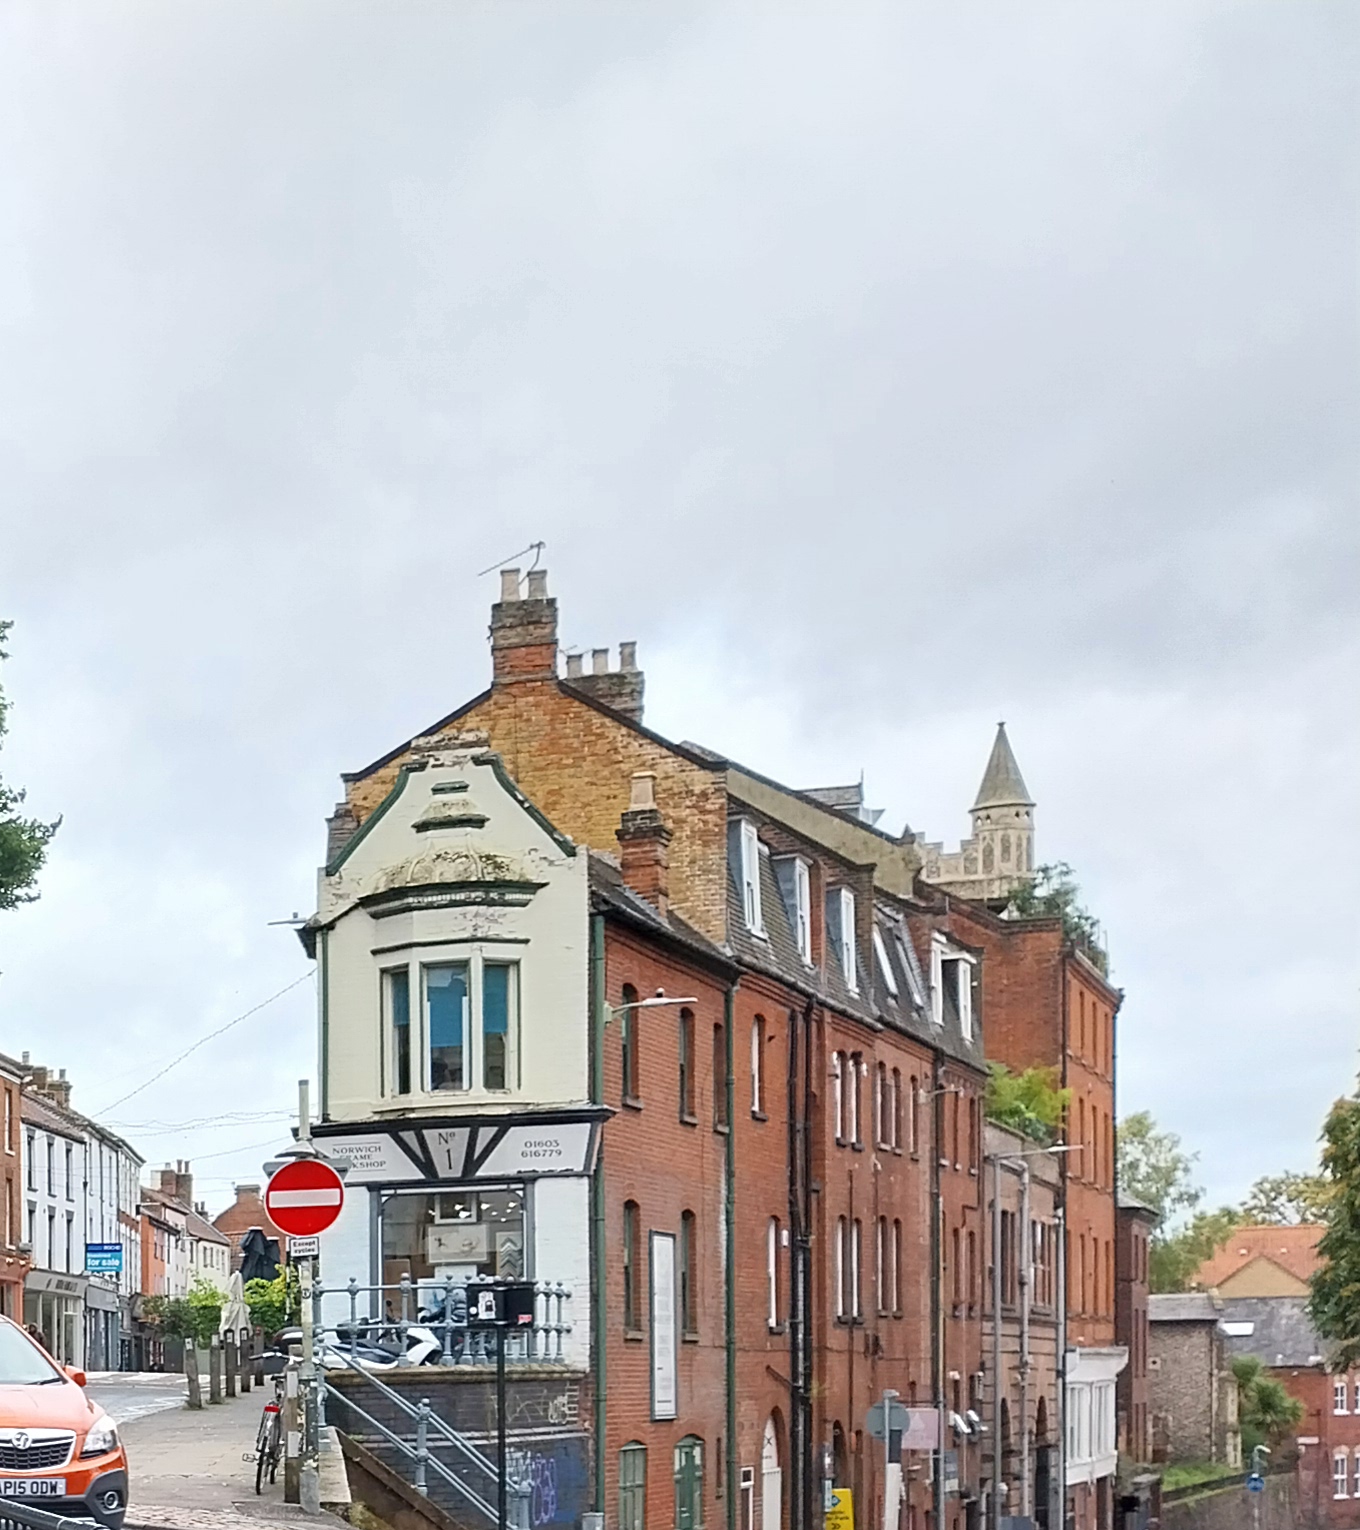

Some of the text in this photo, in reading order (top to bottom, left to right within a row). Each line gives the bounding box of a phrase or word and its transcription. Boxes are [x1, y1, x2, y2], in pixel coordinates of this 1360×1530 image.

[524, 1140, 560, 1149] 01603
[332, 1145, 382, 1154] NORWICH
[521, 1149, 562, 1158] 616779
[352, 1160, 387, 1168] KSHOP
[446, 1148, 453, 1171] 1
[87, 1258, 120, 1267] for sale
[30, 1480, 58, 1494] ODW
